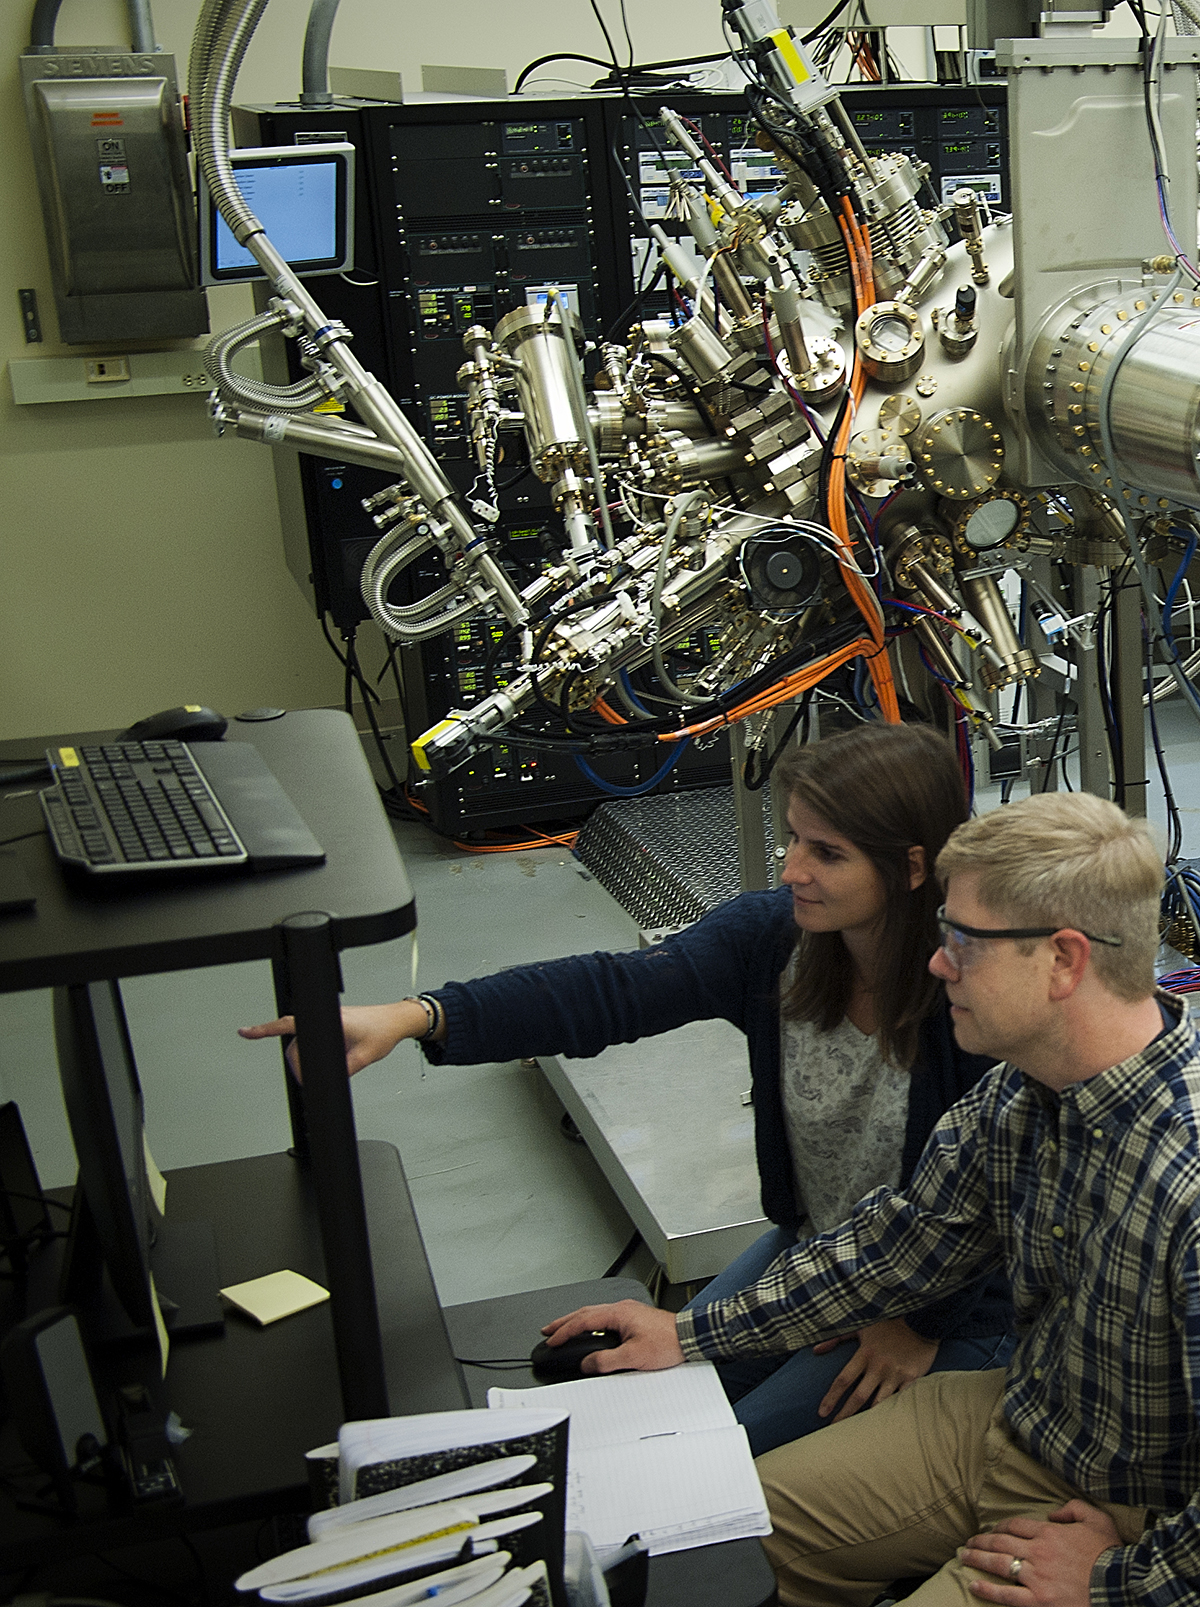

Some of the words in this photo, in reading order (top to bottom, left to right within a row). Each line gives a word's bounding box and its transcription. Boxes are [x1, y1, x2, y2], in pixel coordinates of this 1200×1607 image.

[43, 55, 156, 76] SIEMENS
[102, 141, 120, 152] ON
[105, 183, 128, 193] OFF
